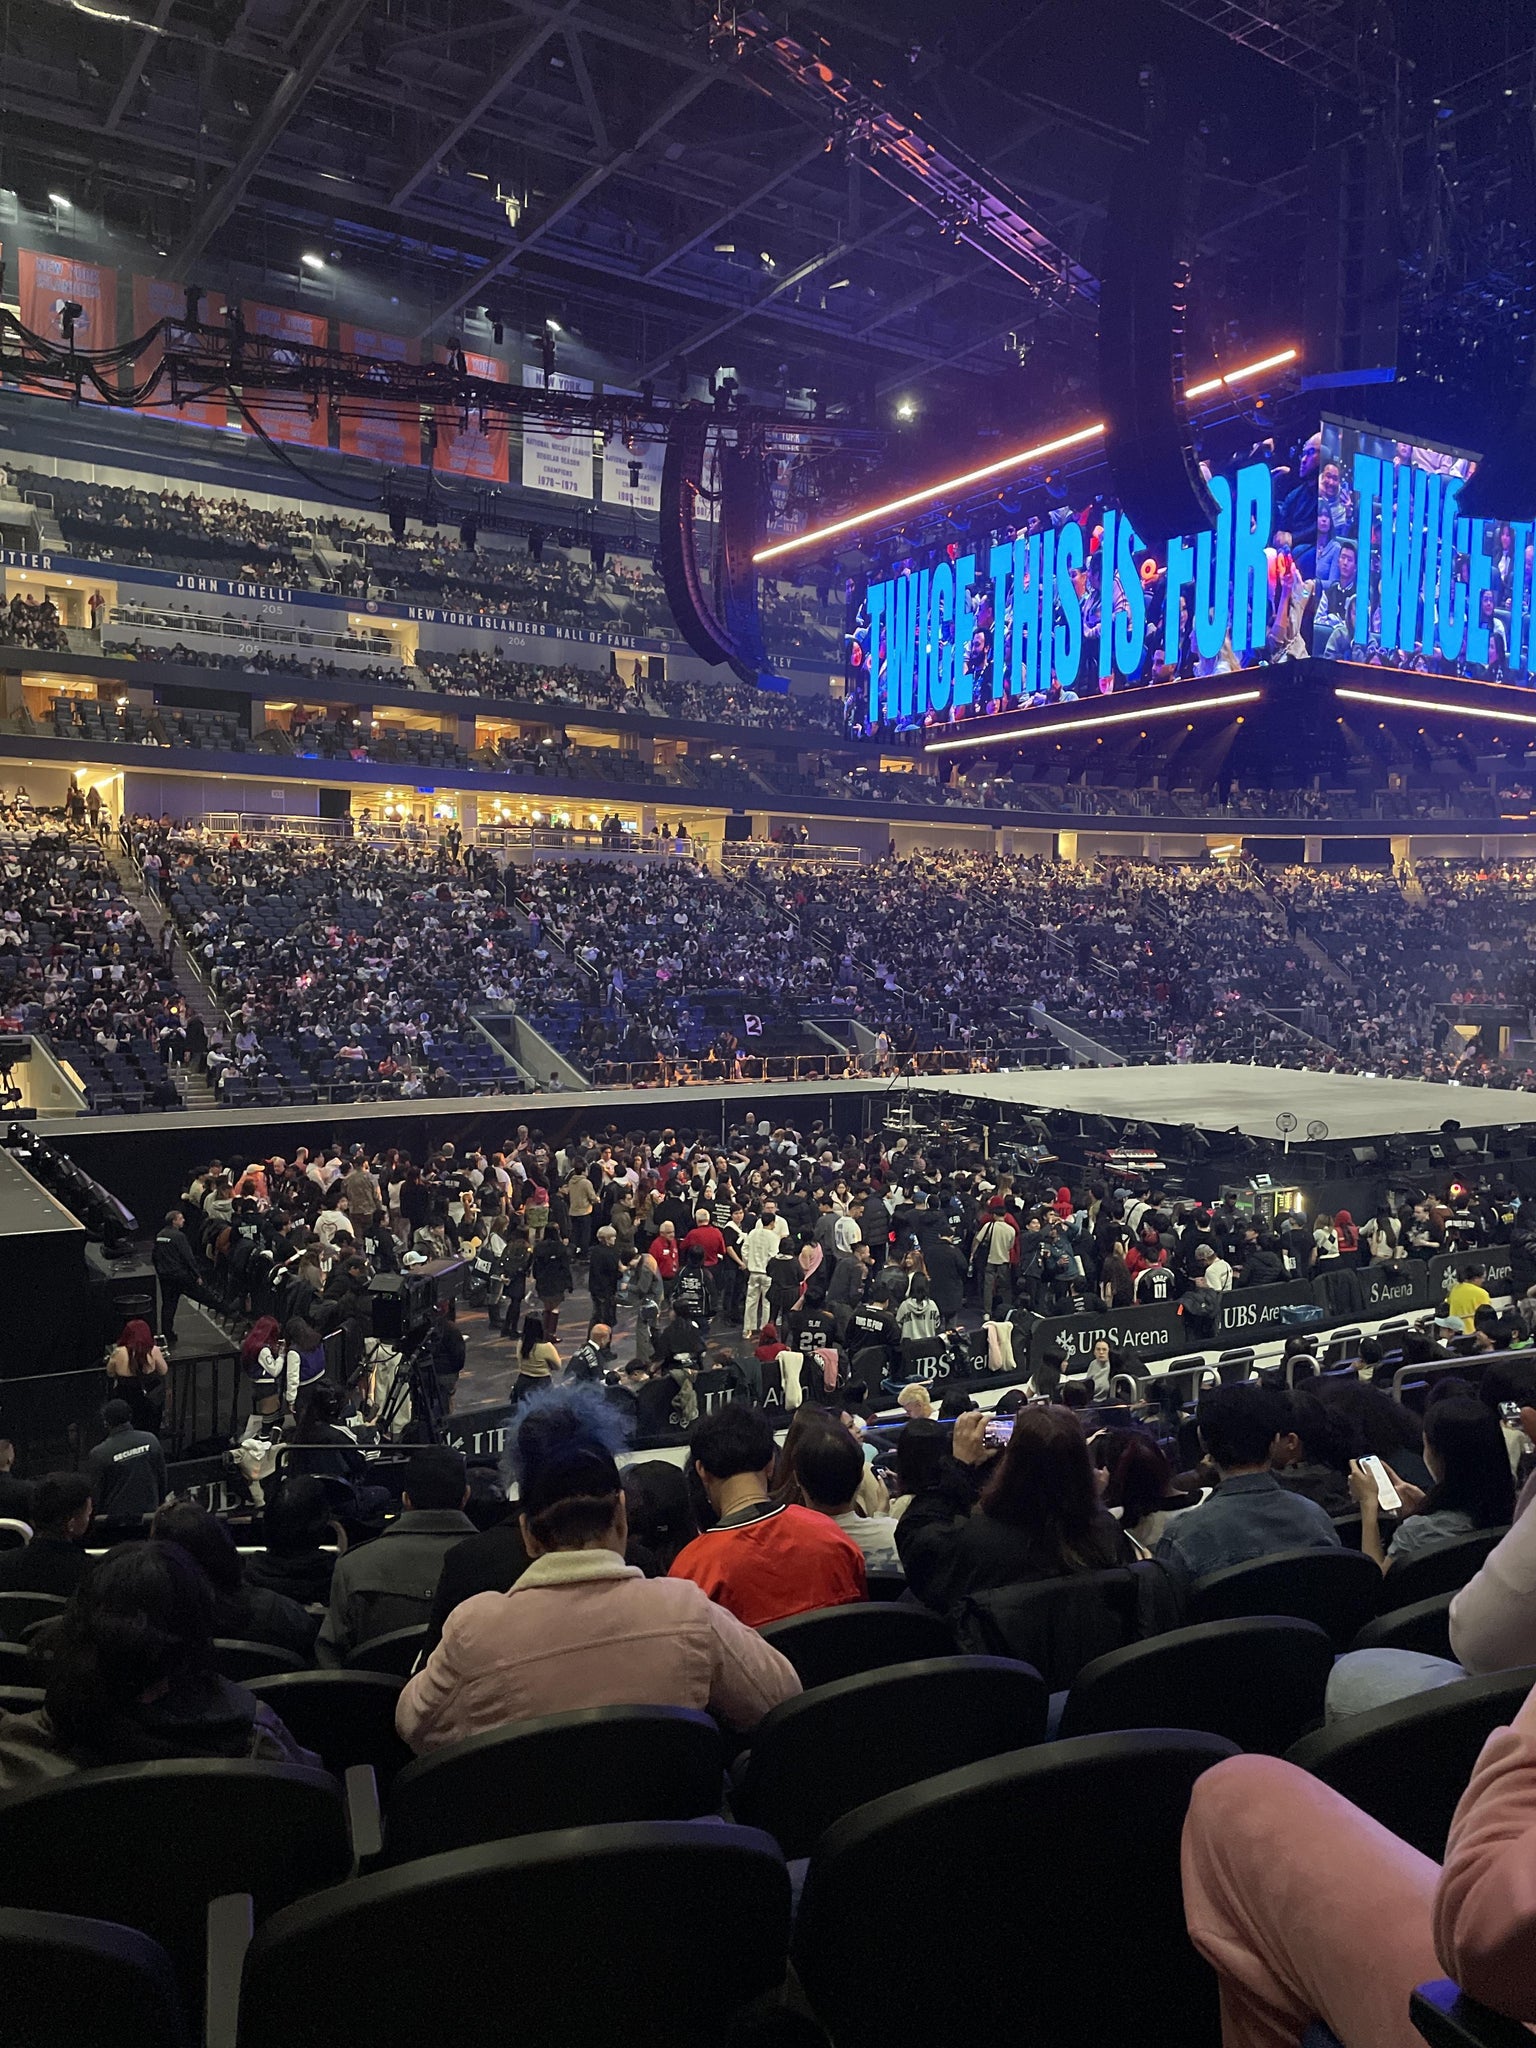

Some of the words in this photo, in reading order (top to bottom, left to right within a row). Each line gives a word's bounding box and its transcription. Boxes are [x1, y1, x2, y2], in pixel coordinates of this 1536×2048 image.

[535, 373, 554, 388] NW
[1353, 452, 1493, 665] TWICE
[176, 575, 218, 592] JOHN
[228, 581, 292, 602] TONELLI
[867, 553, 976, 723] TWICE
[990, 521, 1084, 699] THIS
[1099, 510, 1147, 675] IS
[1164, 462, 1272, 665] FOR
[262, 604, 283, 615] 205
[408, 606, 435, 621] NEW
[442, 612, 473, 627] YORK
[480, 617, 546, 636] ISLANDERS
[556, 627, 584, 641] HALL
[589, 632, 602, 645] OF
[607, 634, 636, 648] FAME
[238, 643, 259, 655] 205
[508, 636, 525, 647] 206
[746, 1015, 761, 1034] 2
[1154, 1283, 1168, 1299] 01
[1381, 1281, 1413, 1301] Arena
[1224, 1303, 1257, 1329] UBS
[1259, 1306, 1280, 1323] Are
[800, 1331, 827, 1351] 23
[1122, 1329, 1169, 1347] Arena
[113, 1444, 150, 1463] SECURITY
